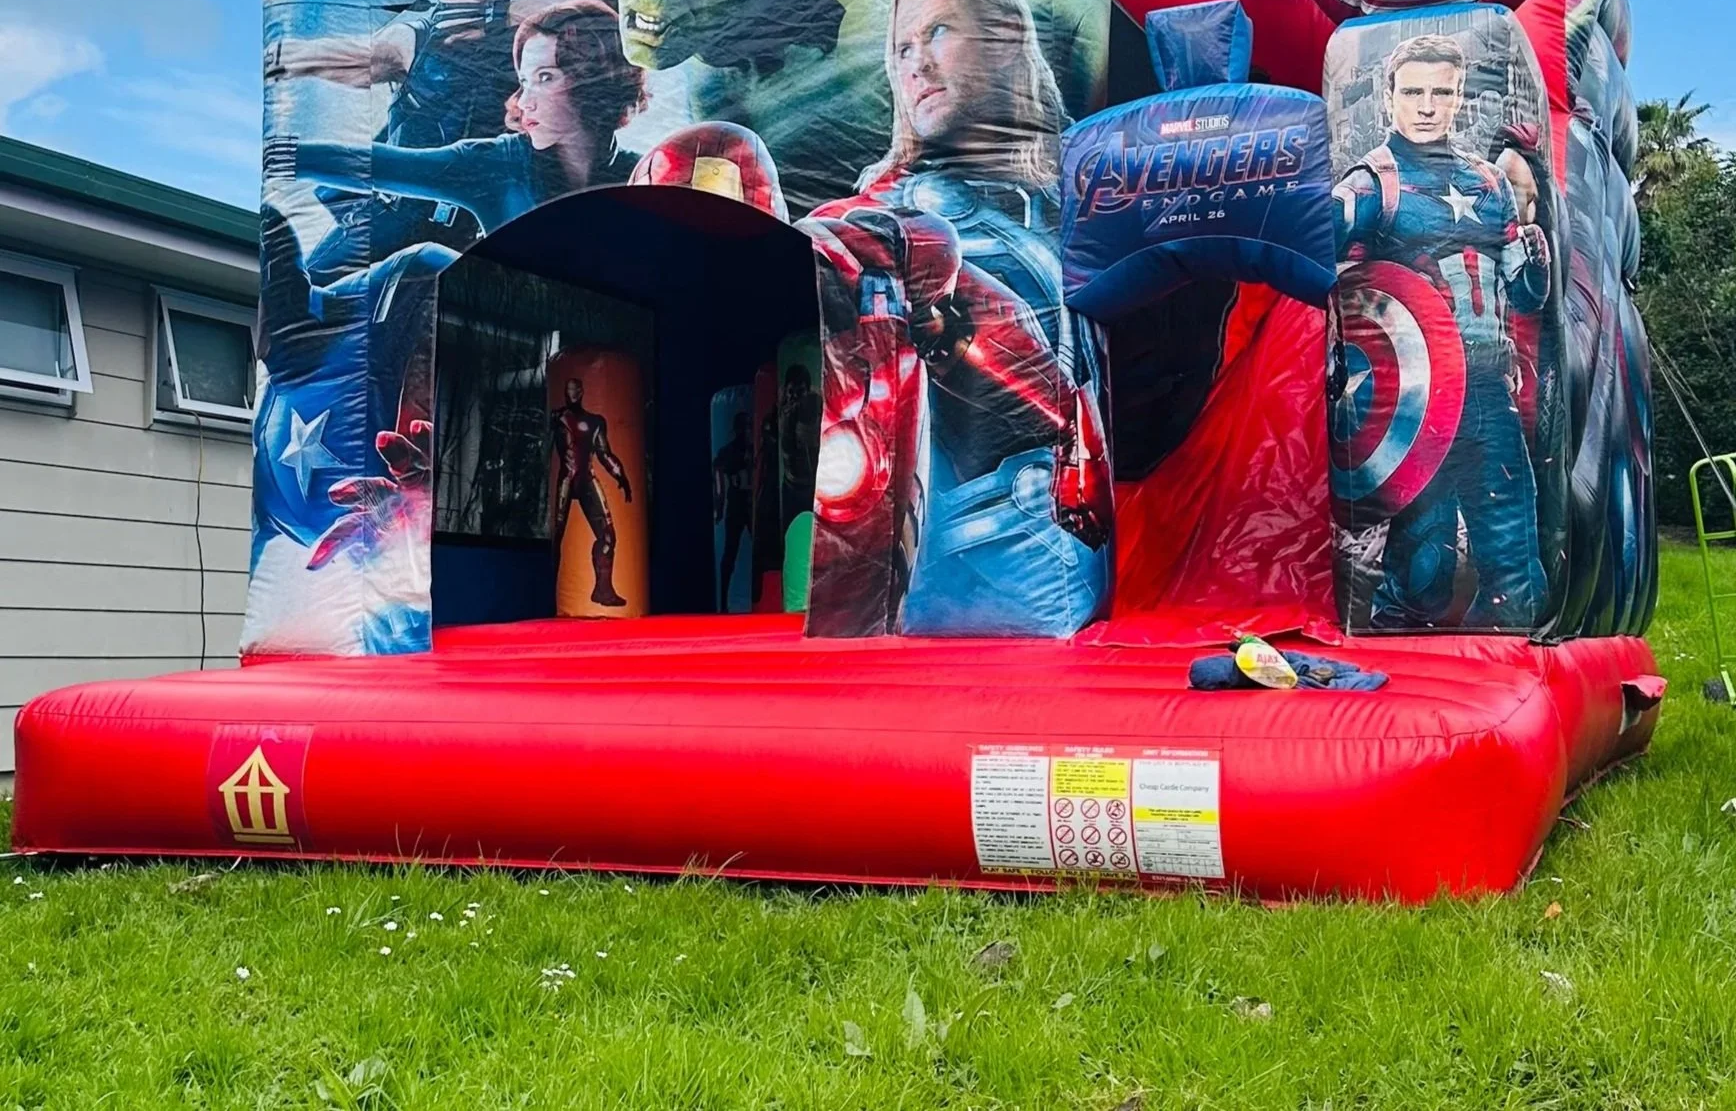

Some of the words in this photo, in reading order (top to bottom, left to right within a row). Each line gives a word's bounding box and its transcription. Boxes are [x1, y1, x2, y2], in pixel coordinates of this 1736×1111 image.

[1160, 120, 1194, 136] MARVEL
[1195, 115, 1229, 131] STUDIOS
[1075, 125, 1309, 222] AVENGERS
[1142, 180, 1299, 211] ENDGAME
[1159, 213, 1201, 226] APRIL
[1207, 209, 1226, 220] 26
[1139, 783, 1159, 792] Cheap
[1160, 783, 1179, 792] Castle
[1180, 784, 1210, 794] Company
